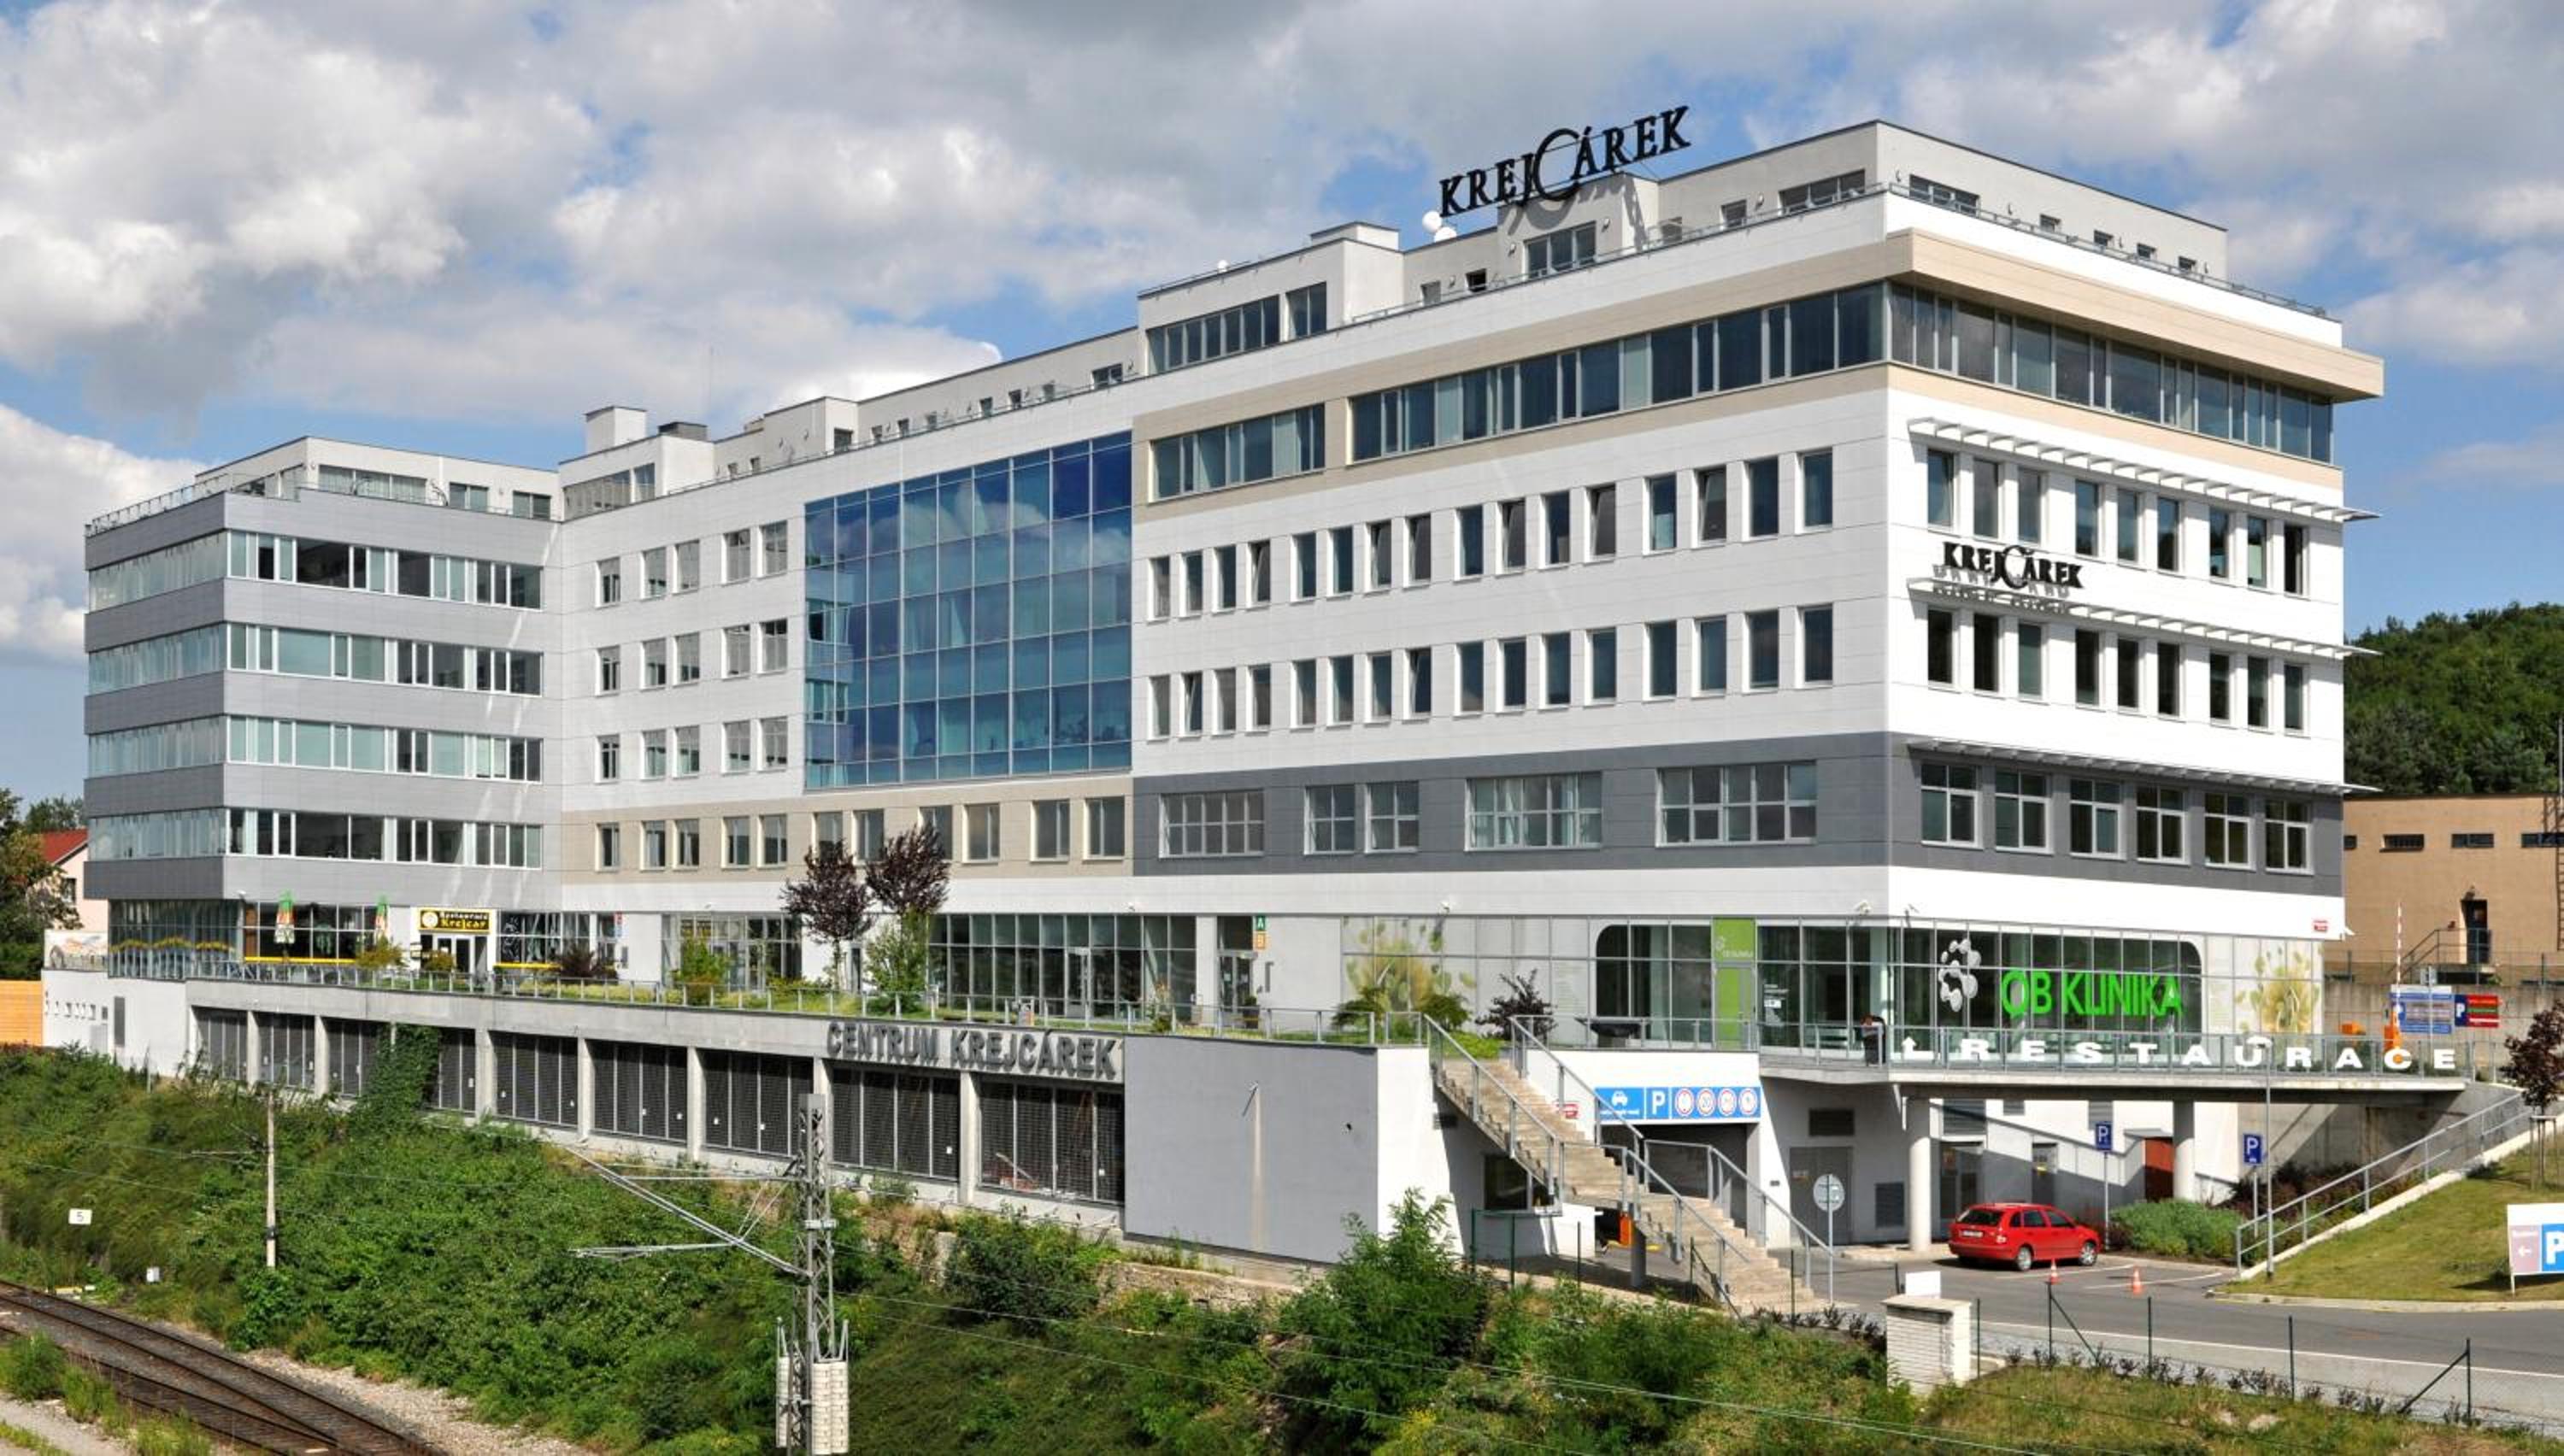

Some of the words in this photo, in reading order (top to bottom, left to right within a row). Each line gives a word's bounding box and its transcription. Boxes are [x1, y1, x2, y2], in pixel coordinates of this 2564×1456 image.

[1438, 105, 1692, 218] KREJCÁREK
[827, 1021, 940, 1065] CENTRUM
[950, 1028, 1117, 1080] KREJCÁREK
[1961, 1037, 2455, 1069] RESTAURACE
[1653, 1090, 1666, 1115] P
[2098, 1125, 2109, 1142] P
[2246, 1136, 2259, 1156] P
[77, 1212, 84, 1222] 5
[2546, 1231, 2564, 1265] P
